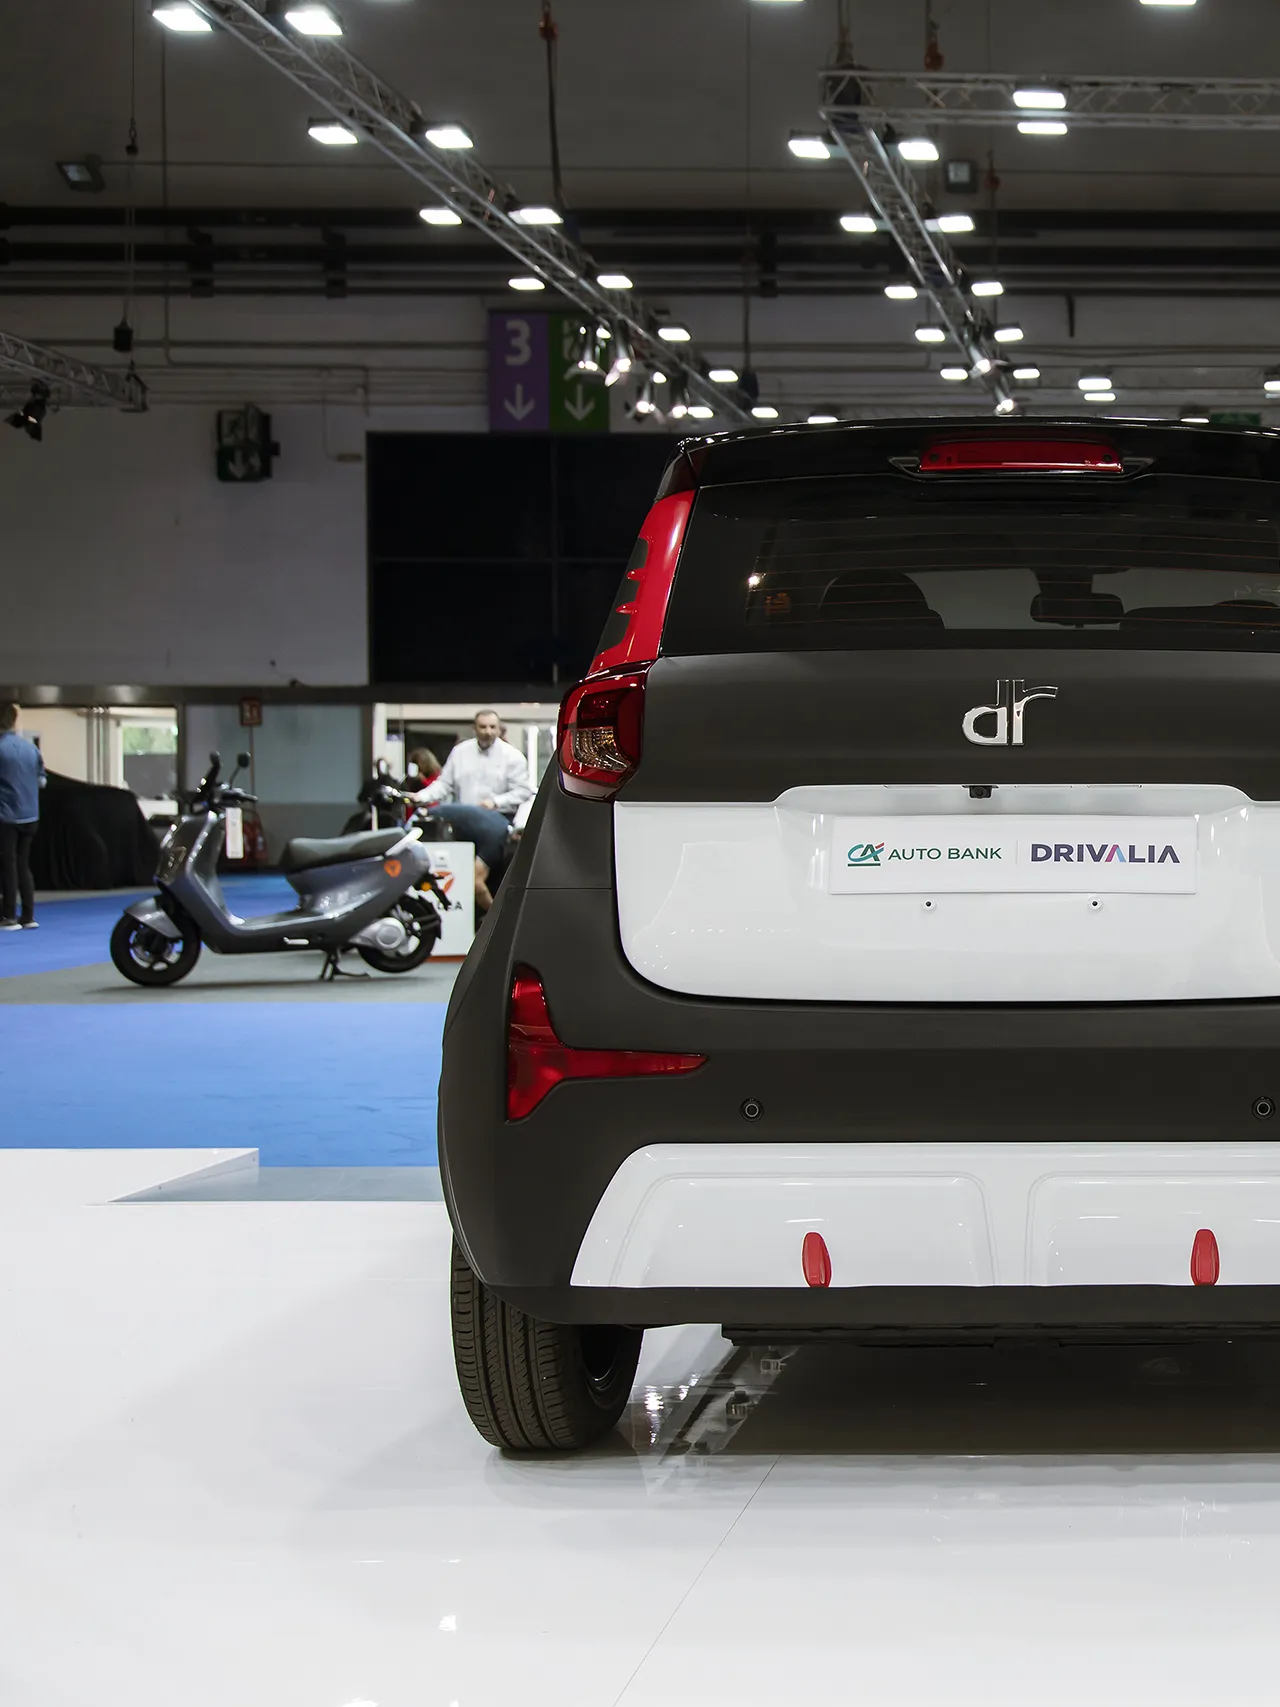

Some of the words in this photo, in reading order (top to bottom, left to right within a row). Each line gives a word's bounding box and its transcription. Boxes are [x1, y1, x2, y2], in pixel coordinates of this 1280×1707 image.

[504, 319, 532, 366] 3
[888, 848, 942, 861] AUTO
[947, 847, 1002, 860] BANK
[1031, 843, 1181, 864] DRIVALIA
